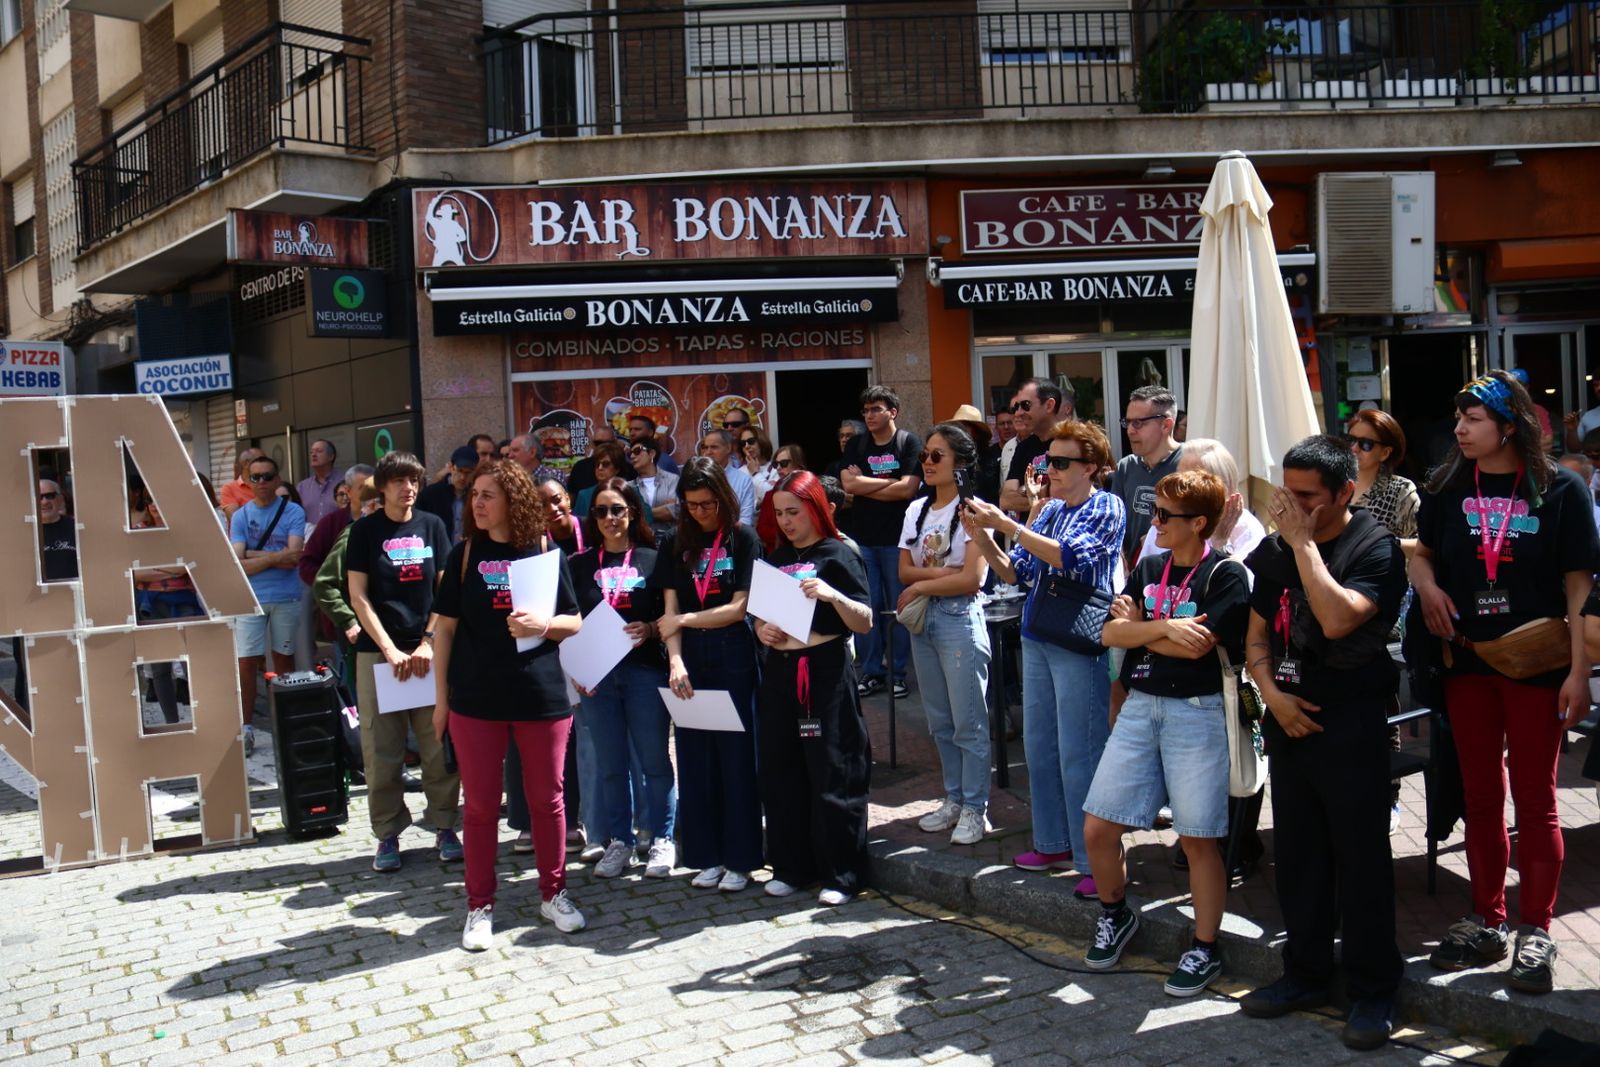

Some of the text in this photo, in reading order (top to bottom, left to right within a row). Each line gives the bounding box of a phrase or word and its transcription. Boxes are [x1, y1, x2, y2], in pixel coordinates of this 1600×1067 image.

[1018, 194, 1107, 214] CAFE
[1136, 192, 1203, 211] BAR
[528, 193, 907, 259] BAR BONANZA
[973, 214, 1205, 249] BONANZ
[274, 229, 293, 242] BAR
[273, 240, 336, 257] BONANZA
[241, 273, 277, 301] CENTRO
[277, 269, 291, 288] DE
[958, 280, 1054, 303] CAFE-BAR
[1062, 273, 1174, 301] BONANZA
[585, 296, 750, 328] BONANZA
[760, 299, 860, 316] Estrella Galicia
[316, 311, 384, 322] NEUROHELP
[459, 307, 563, 326] Estrella Galicia
[515, 329, 865, 358] COMBINADOS TAPAS RACIONES
[11, 349, 60, 366] PIZZA
[146, 358, 221, 379] ASOCIACIÓN
[139, 373, 230, 394] COCONUT
[634, 389, 662, 399] PATATAS
[634, 397, 661, 407] BRAVAS
[570, 419, 587, 430] HAM
[570, 429, 586, 439] BUR
[570, 437, 590, 447] GUER
[571, 446, 586, 456] SAS
[1478, 596, 1506, 605] OLALLA
[1280, 661, 1296, 669] JUAN
